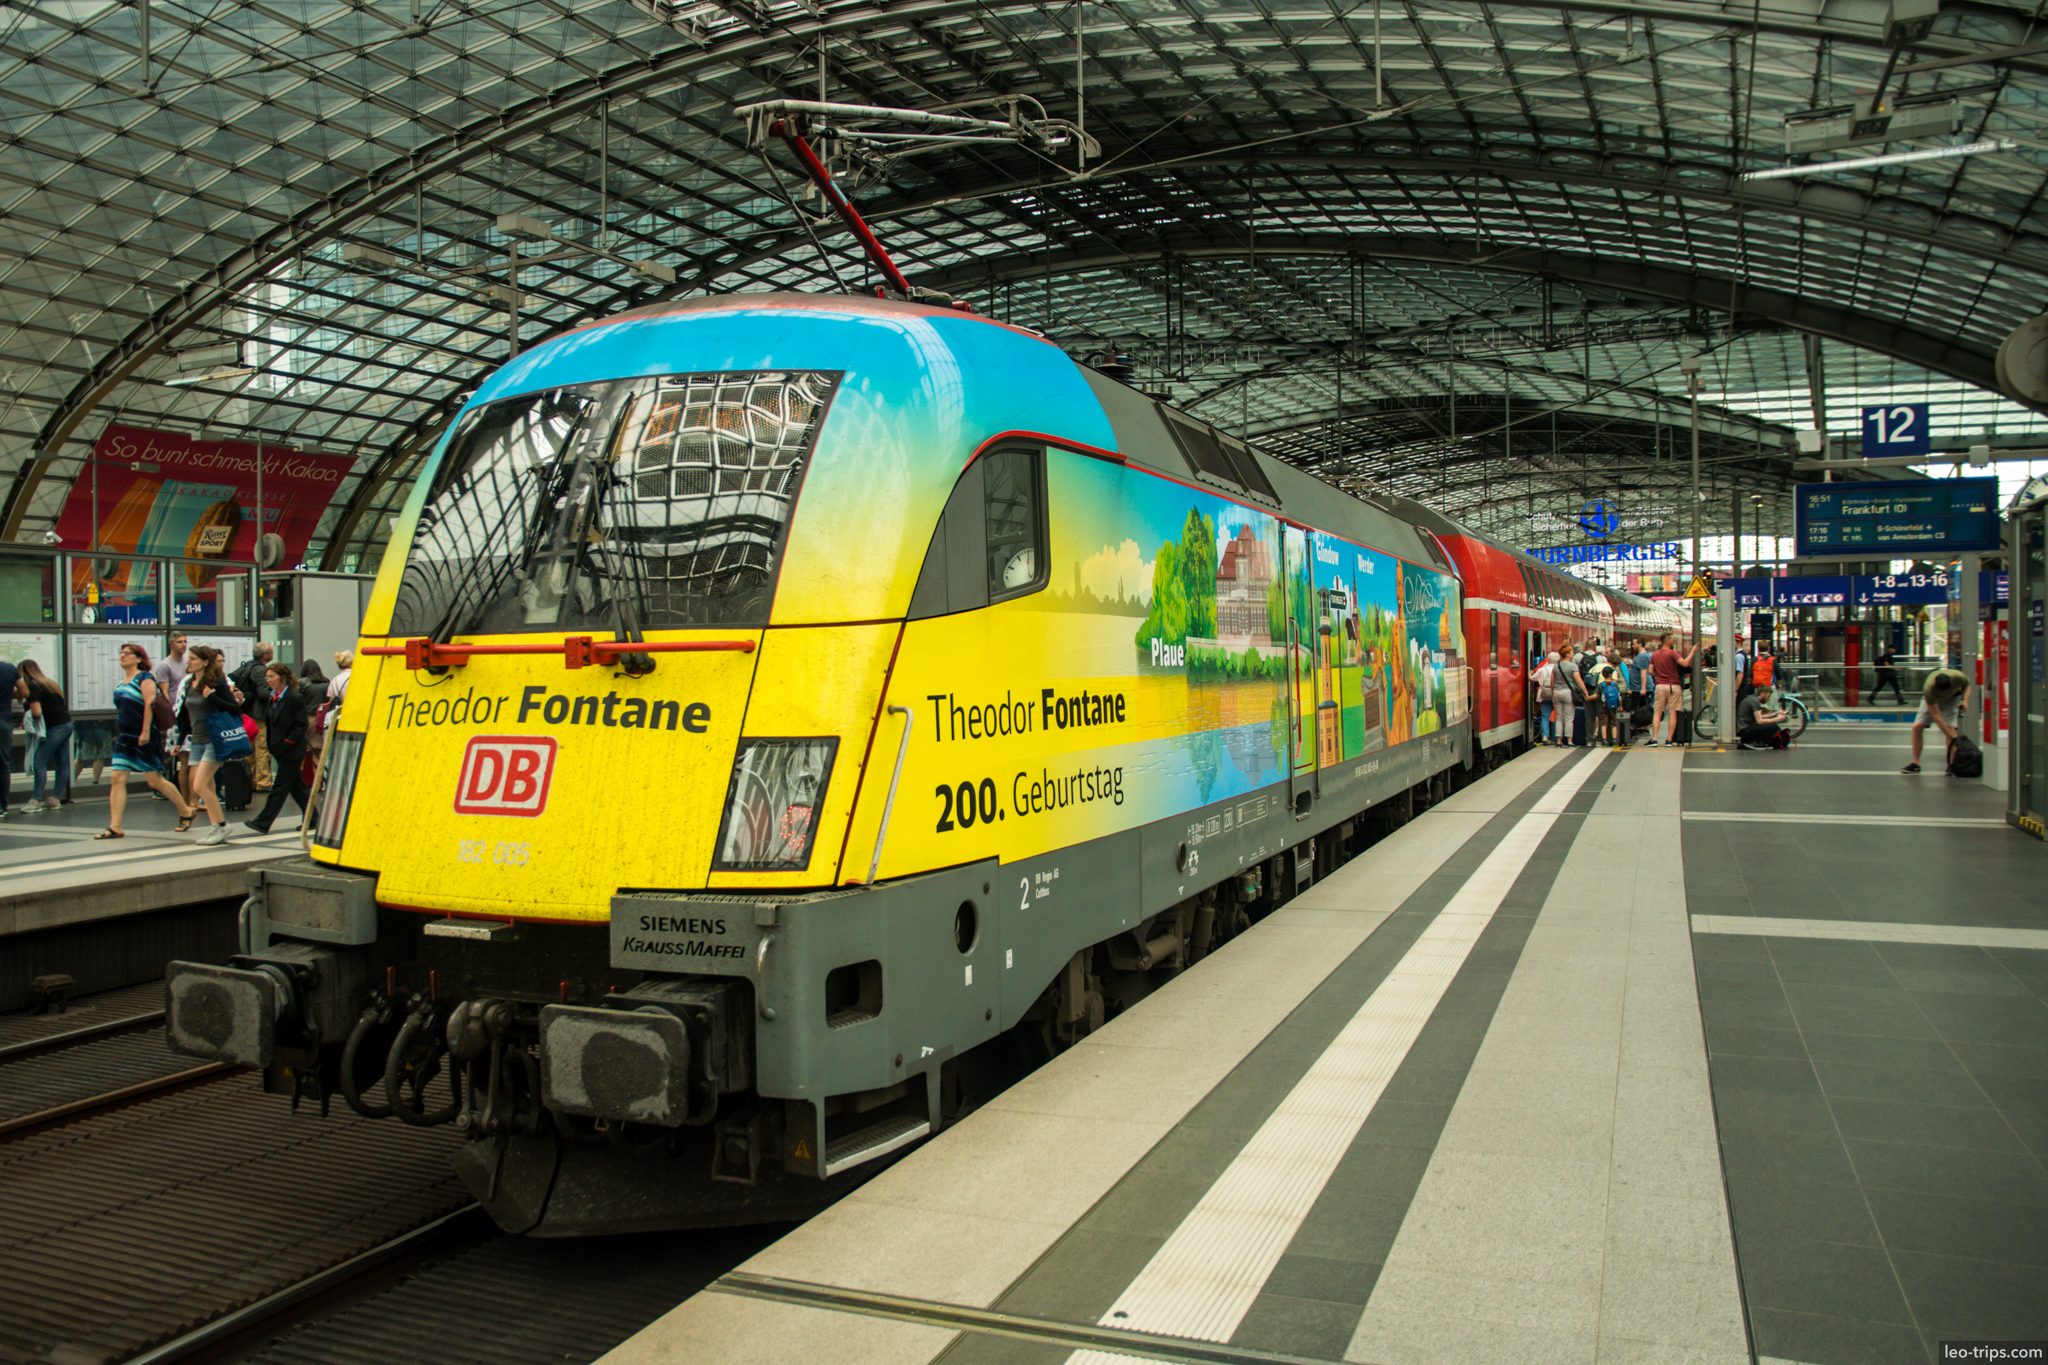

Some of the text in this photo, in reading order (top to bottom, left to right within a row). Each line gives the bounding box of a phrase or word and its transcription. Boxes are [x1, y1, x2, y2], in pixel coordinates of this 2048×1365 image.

[1868, 406, 1915, 443] 12
[105, 436, 338, 482] So bunt schmeckt Kakao.
[1842, 505, 1890, 515] Frankfurt
[1621, 519, 1638, 528] der
[1316, 541, 1339, 566] Glindow
[1357, 553, 1374, 575] Werder
[1872, 575, 1896, 588] 1-8
[1909, 574, 1948, 587] 13-16
[186, 604, 202, 613] 11-14
[1735, 613, 1741, 621] 5
[1151, 637, 1185, 667] Plaue
[386, 685, 711, 734] Theodor Fontane
[927, 688, 1126, 742] Theodor Fontane
[465, 748, 542, 803] DB
[935, 765, 1125, 834] 200. Geburtstag
[458, 840, 531, 866] 182 005
[1020, 877, 1029, 911] 2
[1042, 869, 1053, 884] Regio
[1053, 867, 1060, 879] AG
[640, 915, 726, 935] SIEMENS
